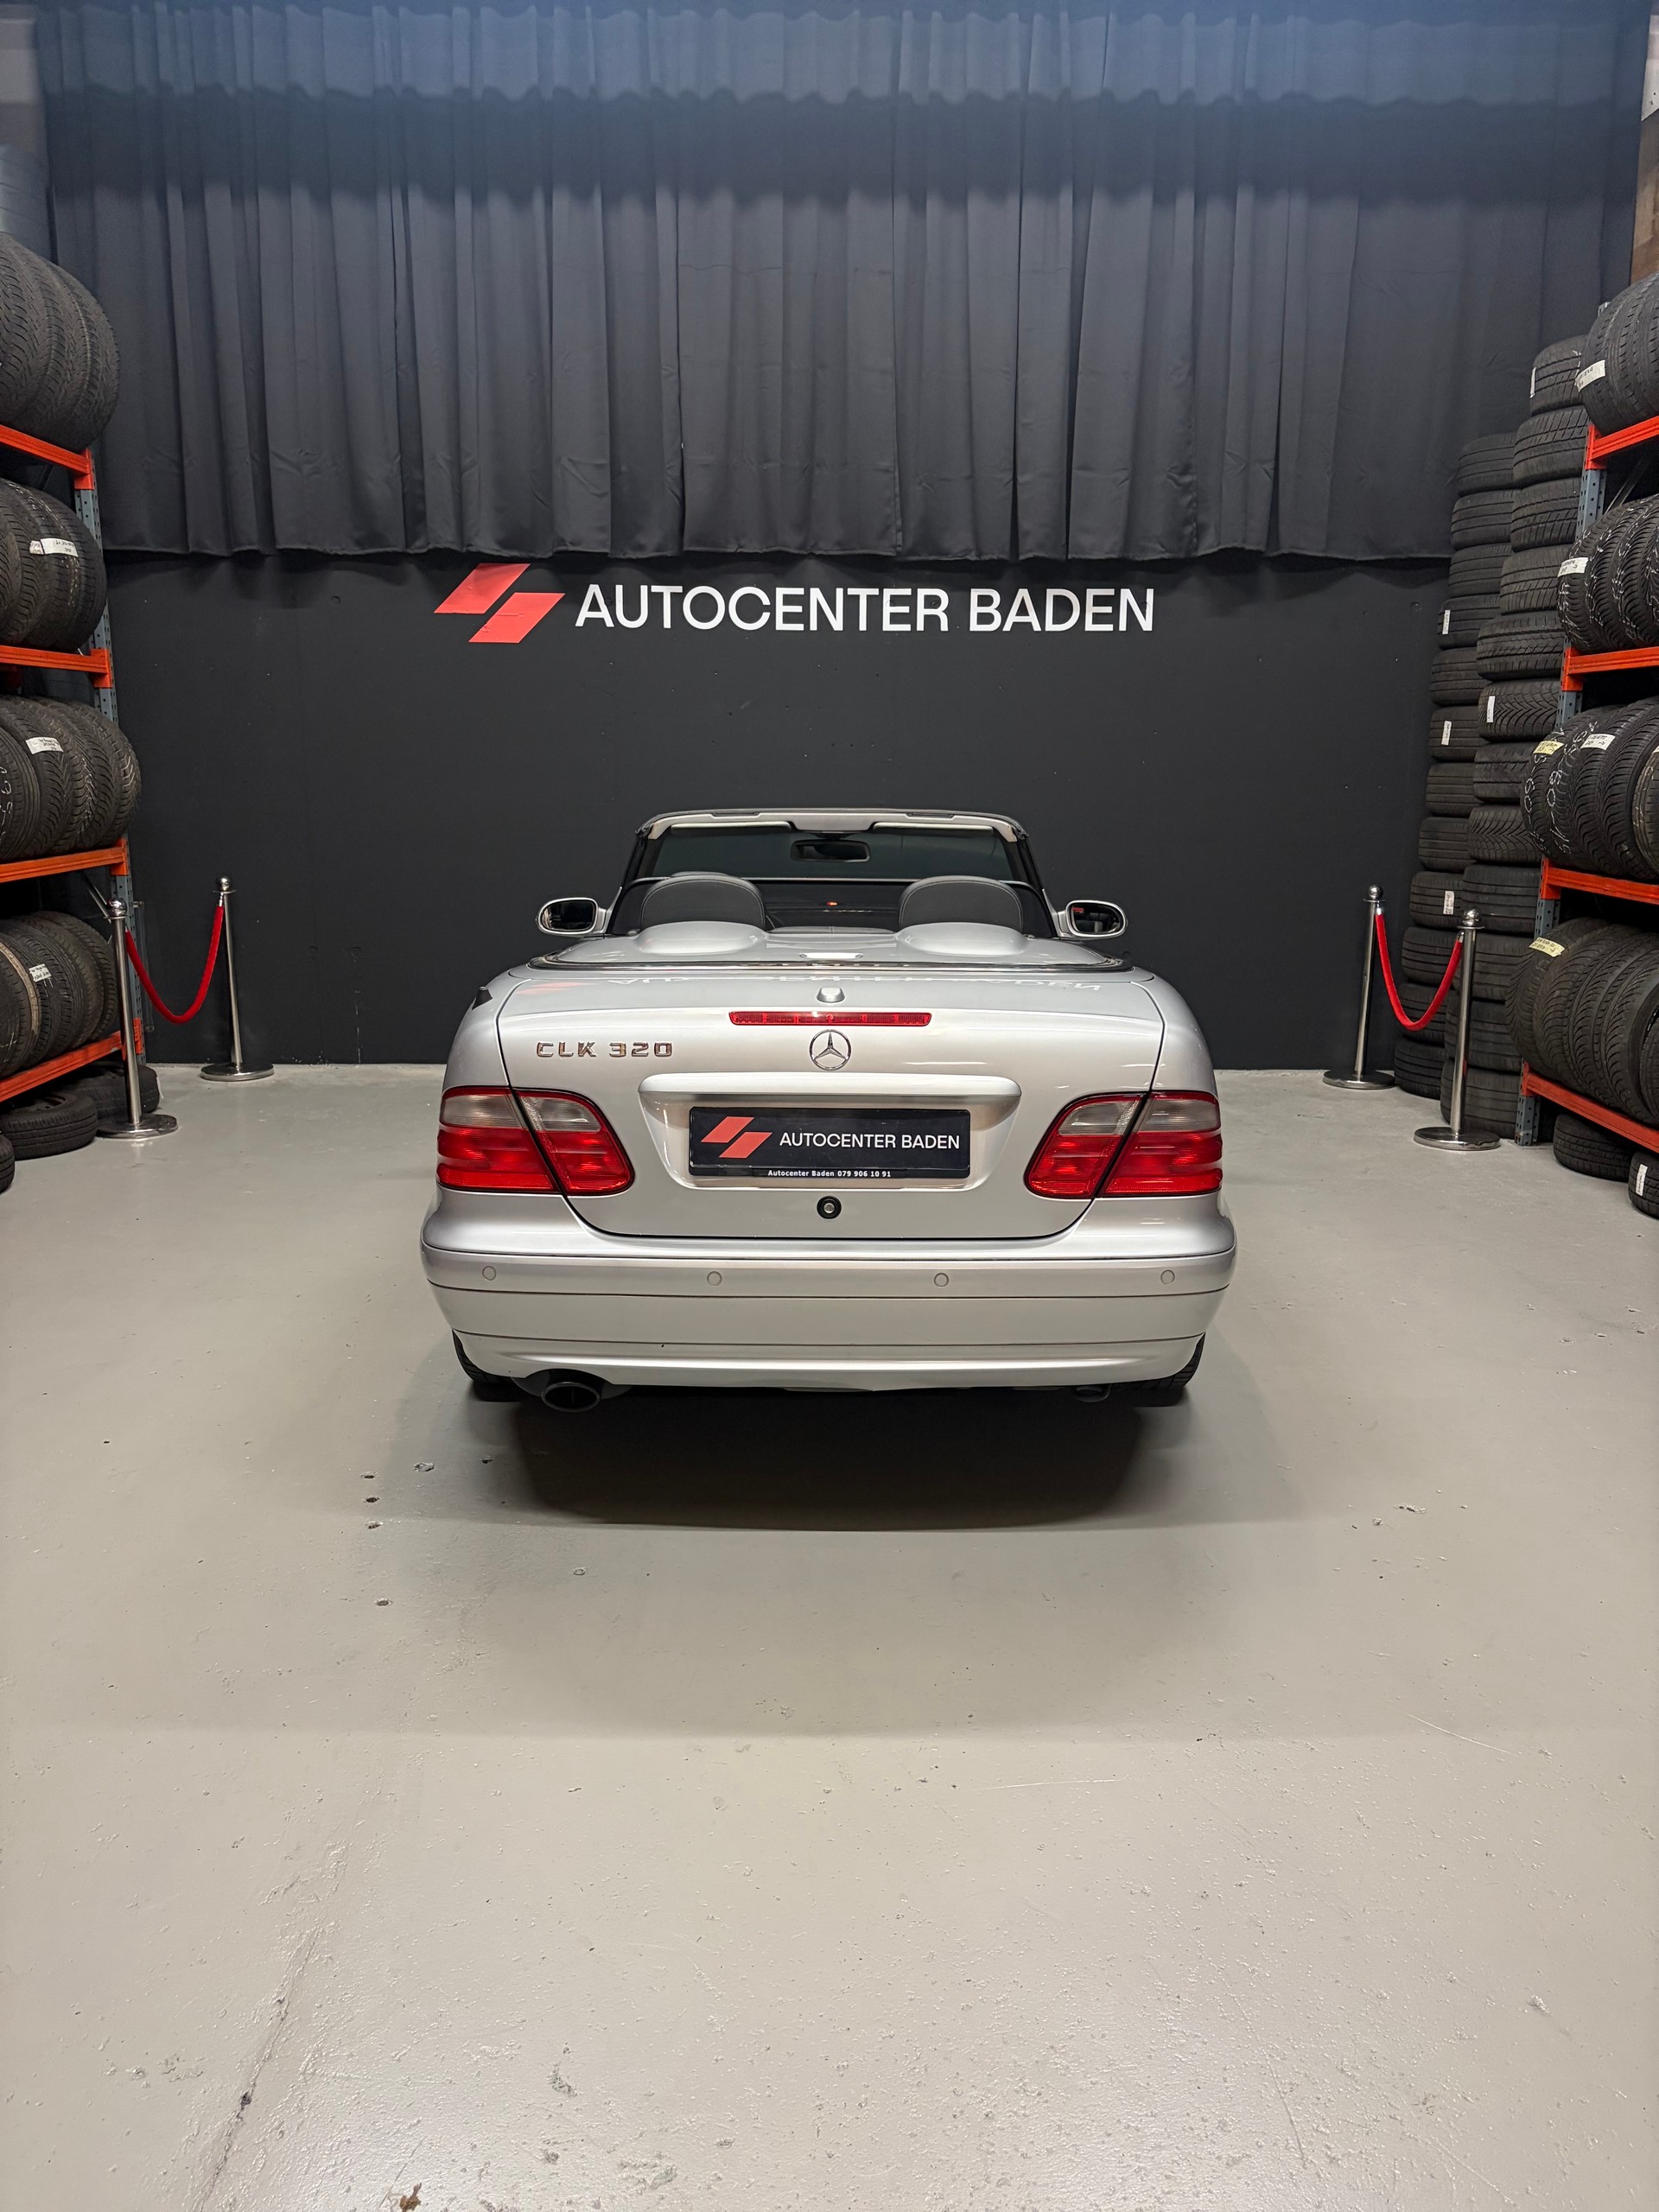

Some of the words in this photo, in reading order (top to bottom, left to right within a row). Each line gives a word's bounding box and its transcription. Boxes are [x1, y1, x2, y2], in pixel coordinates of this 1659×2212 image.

[575, 583, 950, 632] AUTOCENTER
[969, 588, 1154, 632] BADEN
[536, 1041, 597, 1058] CLK
[608, 1041, 673, 1058] 320
[779, 1132, 896, 1148] AUTOCENTER
[901, 1134, 960, 1149] BADEN
